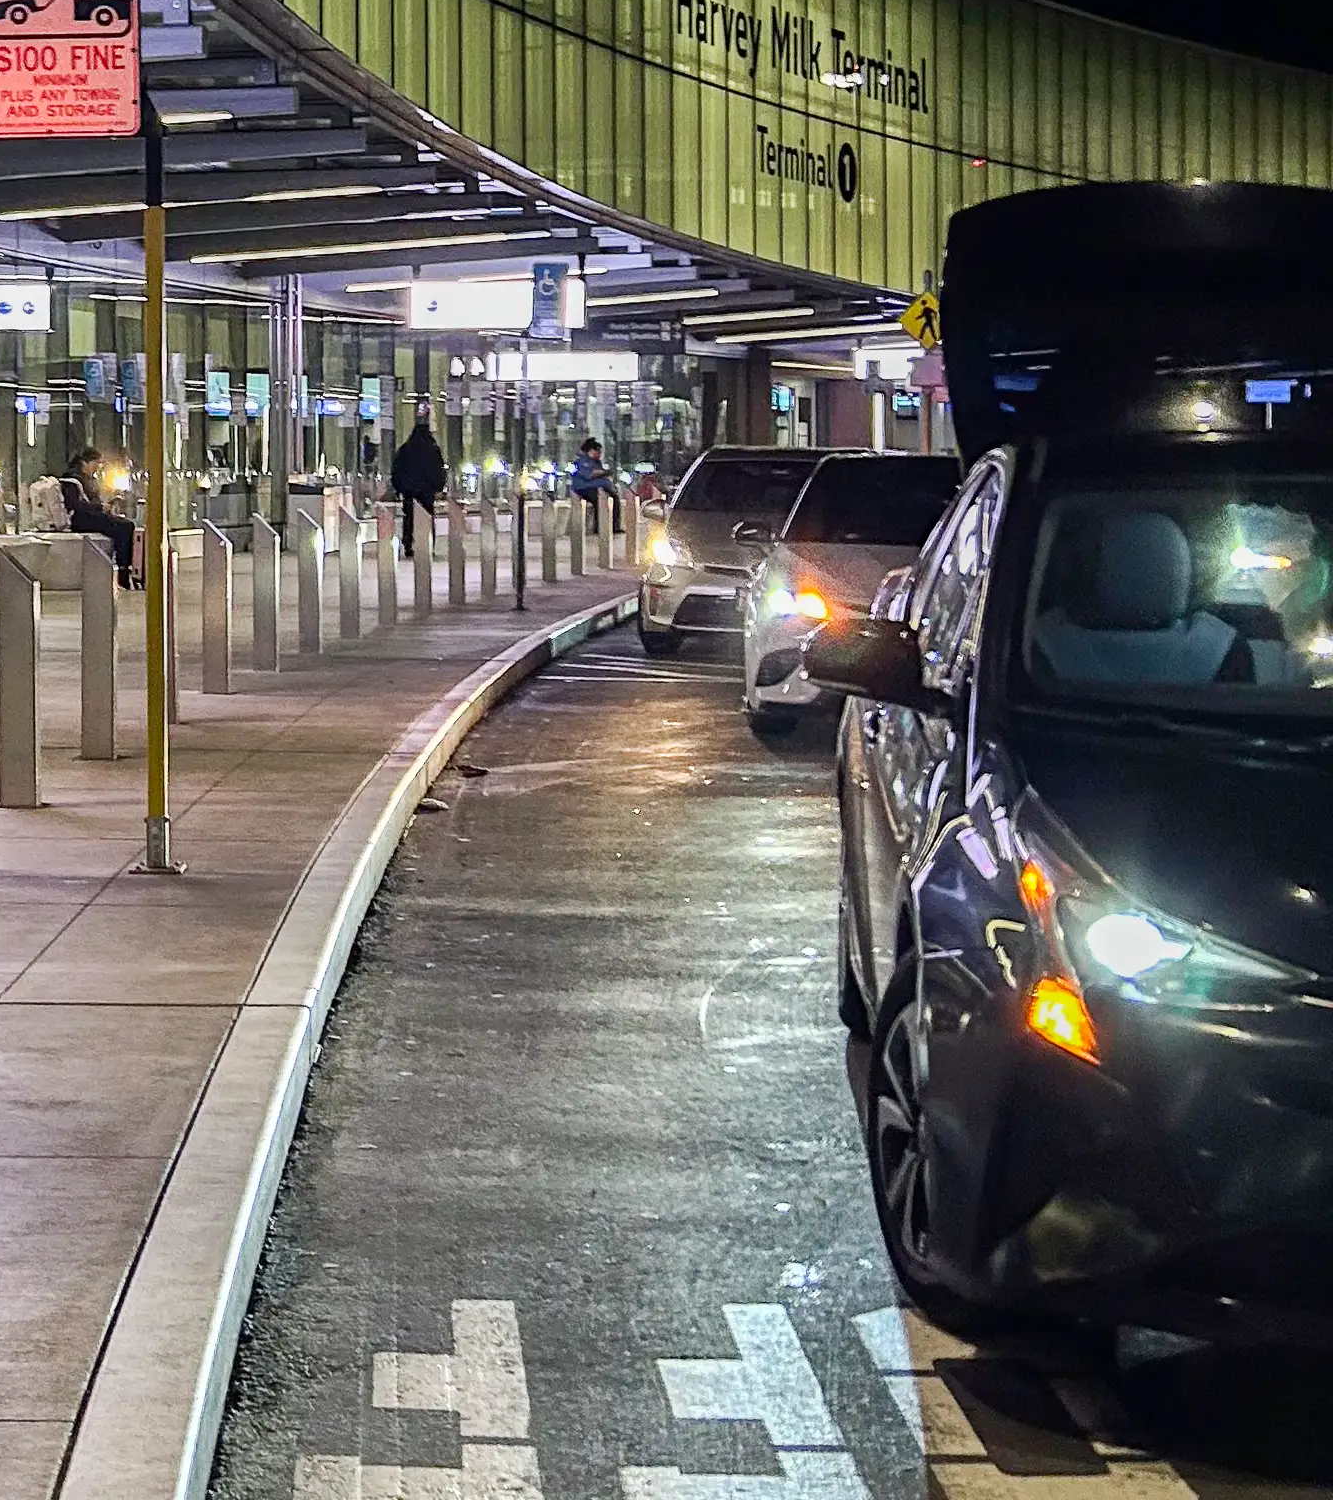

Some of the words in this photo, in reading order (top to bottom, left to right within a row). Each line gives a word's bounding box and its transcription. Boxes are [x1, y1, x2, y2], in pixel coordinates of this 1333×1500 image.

[70, 45, 125, 71] FINE
[771, 5, 822, 84] Milk
[831, 27, 928, 114] Terminal
[0, 89, 34, 102] PLUS
[40, 88, 68, 101] ANY
[73, 87, 121, 101] TOWING
[6, 104, 39, 117] AND
[46, 103, 117, 117] STORAGE
[756, 124, 834, 189] Terminal
